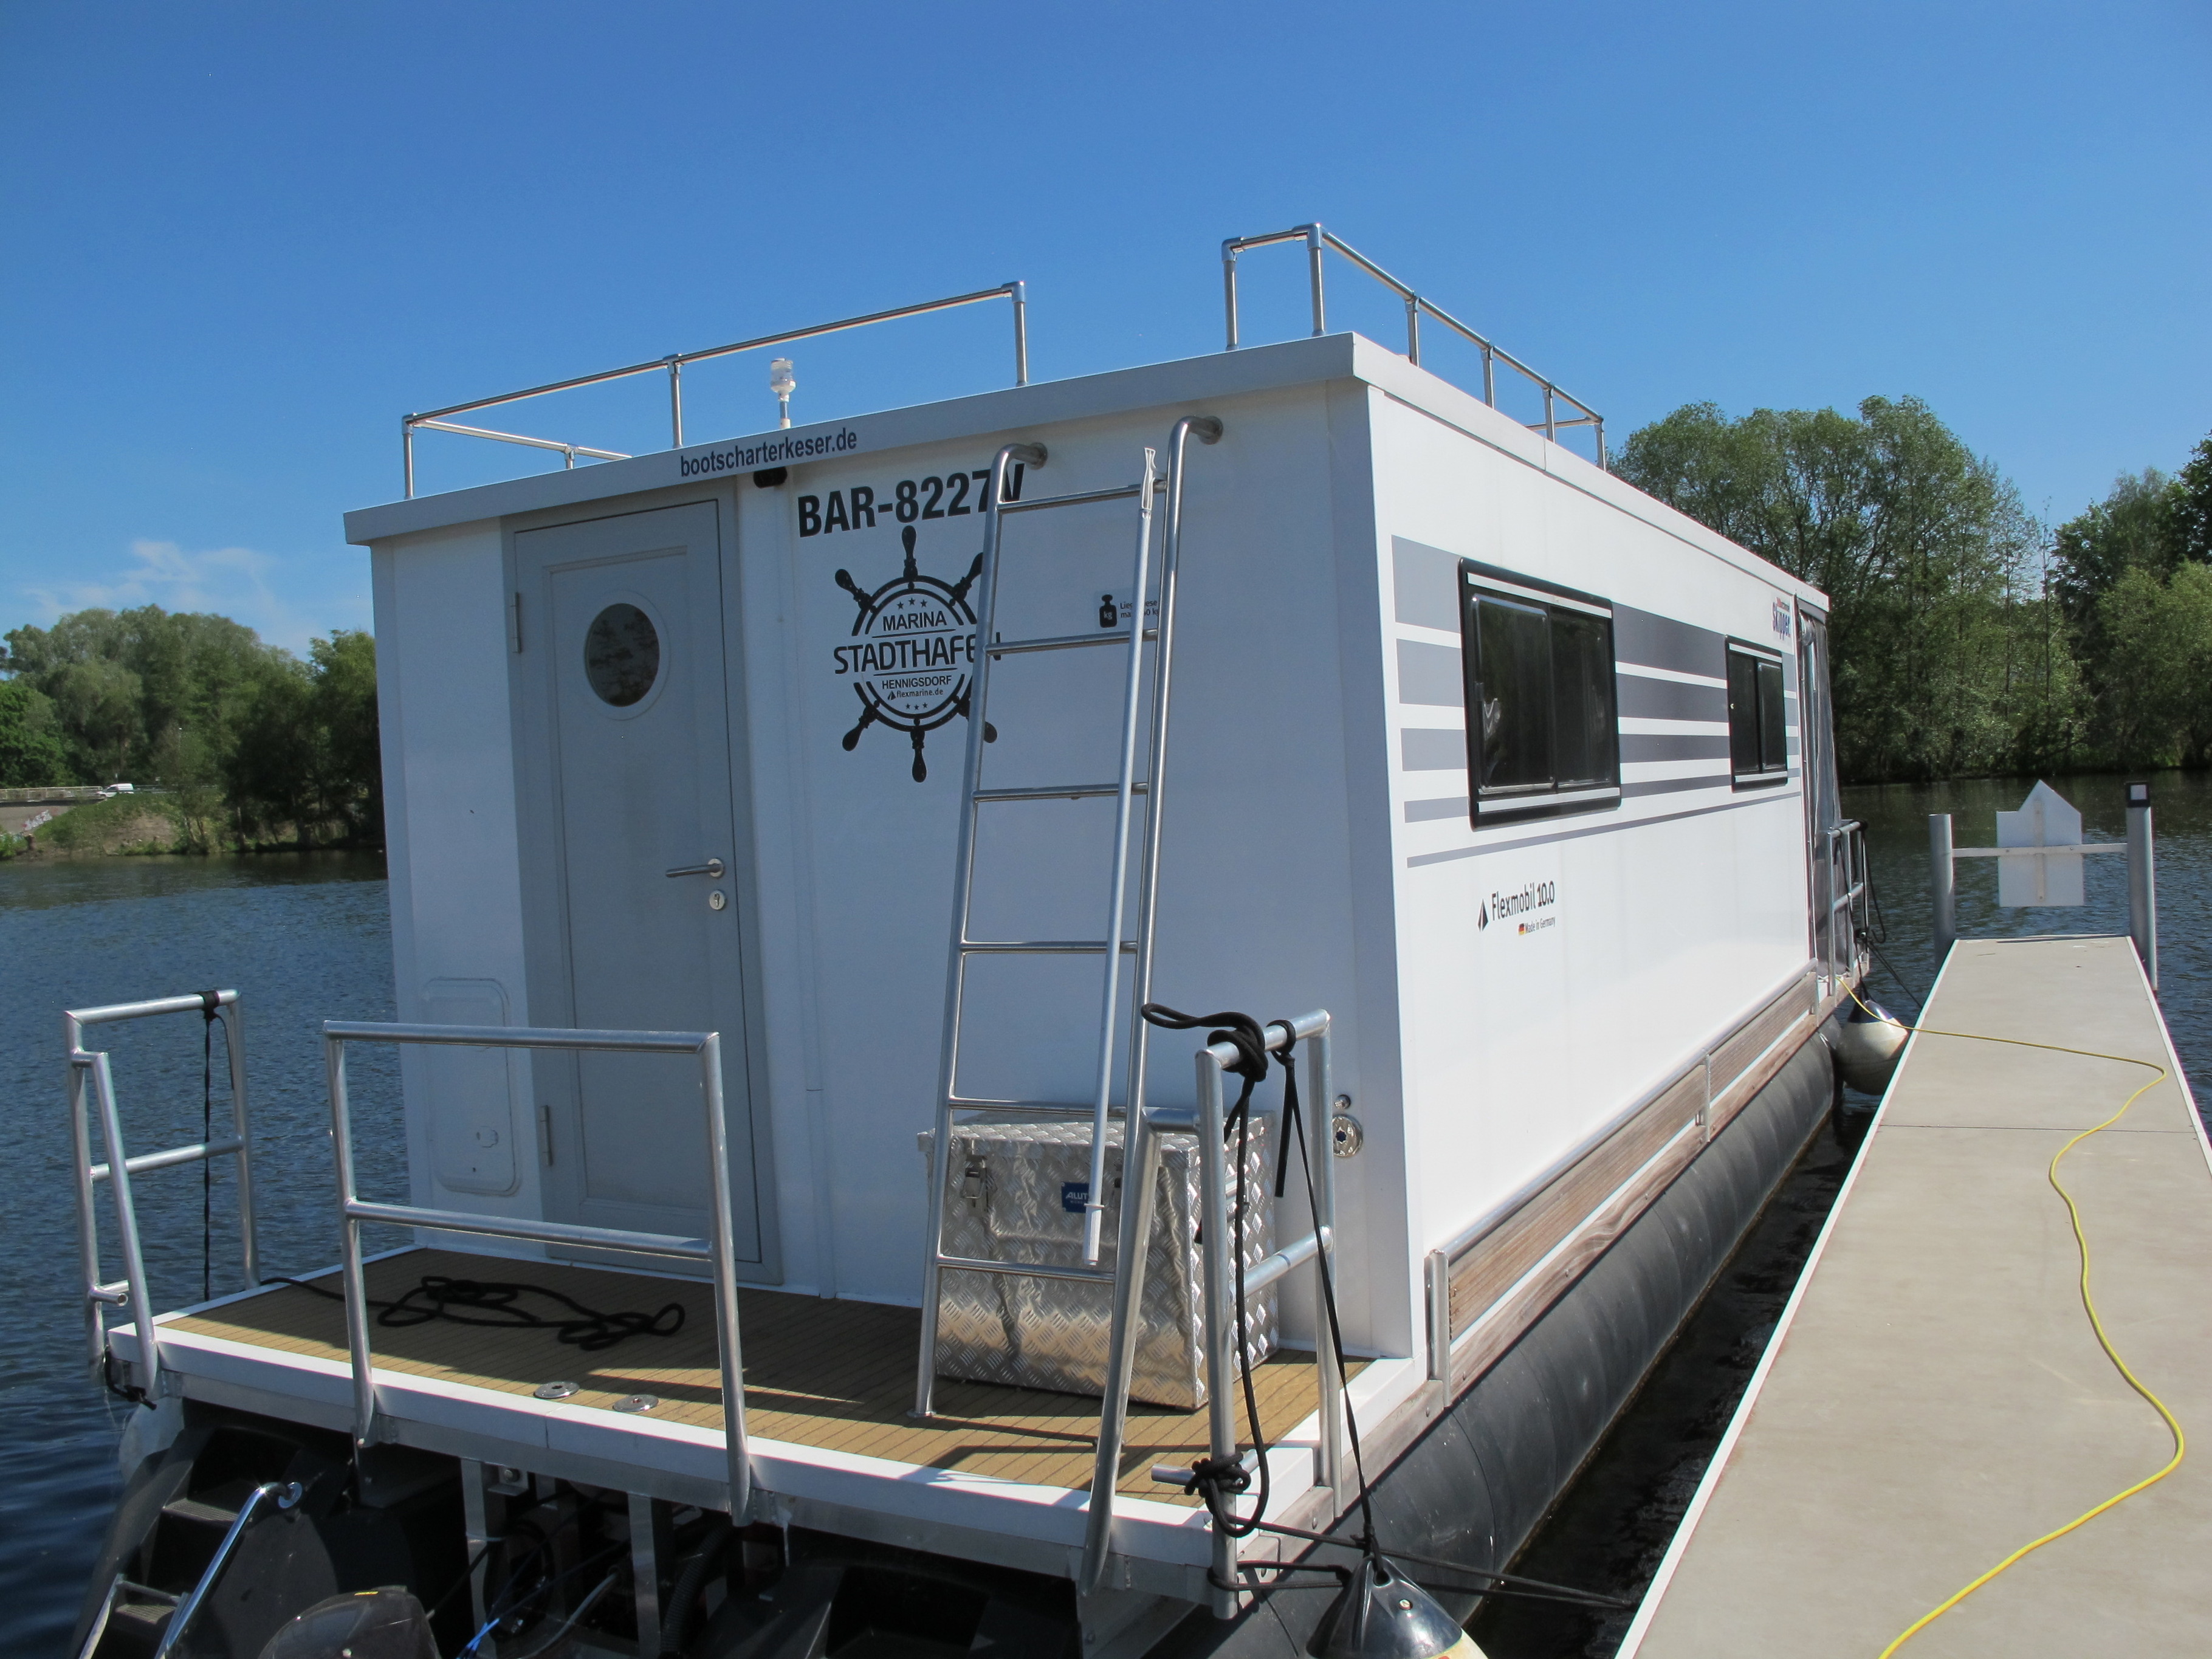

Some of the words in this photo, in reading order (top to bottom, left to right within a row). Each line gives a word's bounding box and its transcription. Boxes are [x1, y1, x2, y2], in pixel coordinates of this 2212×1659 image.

[681, 427, 857, 477] bootscharterkeser.de
[882, 610, 947, 631] MARINA
[1104, 610, 1113, 620] kg
[882, 675, 952, 690] HENNIGSDORF
[896, 689, 944, 698] flexmarine.de
[1491, 882, 1536, 921] Flexmobil
[1536, 880, 1555, 907] 10.0
[1065, 1192, 1088, 1200] ALUT
